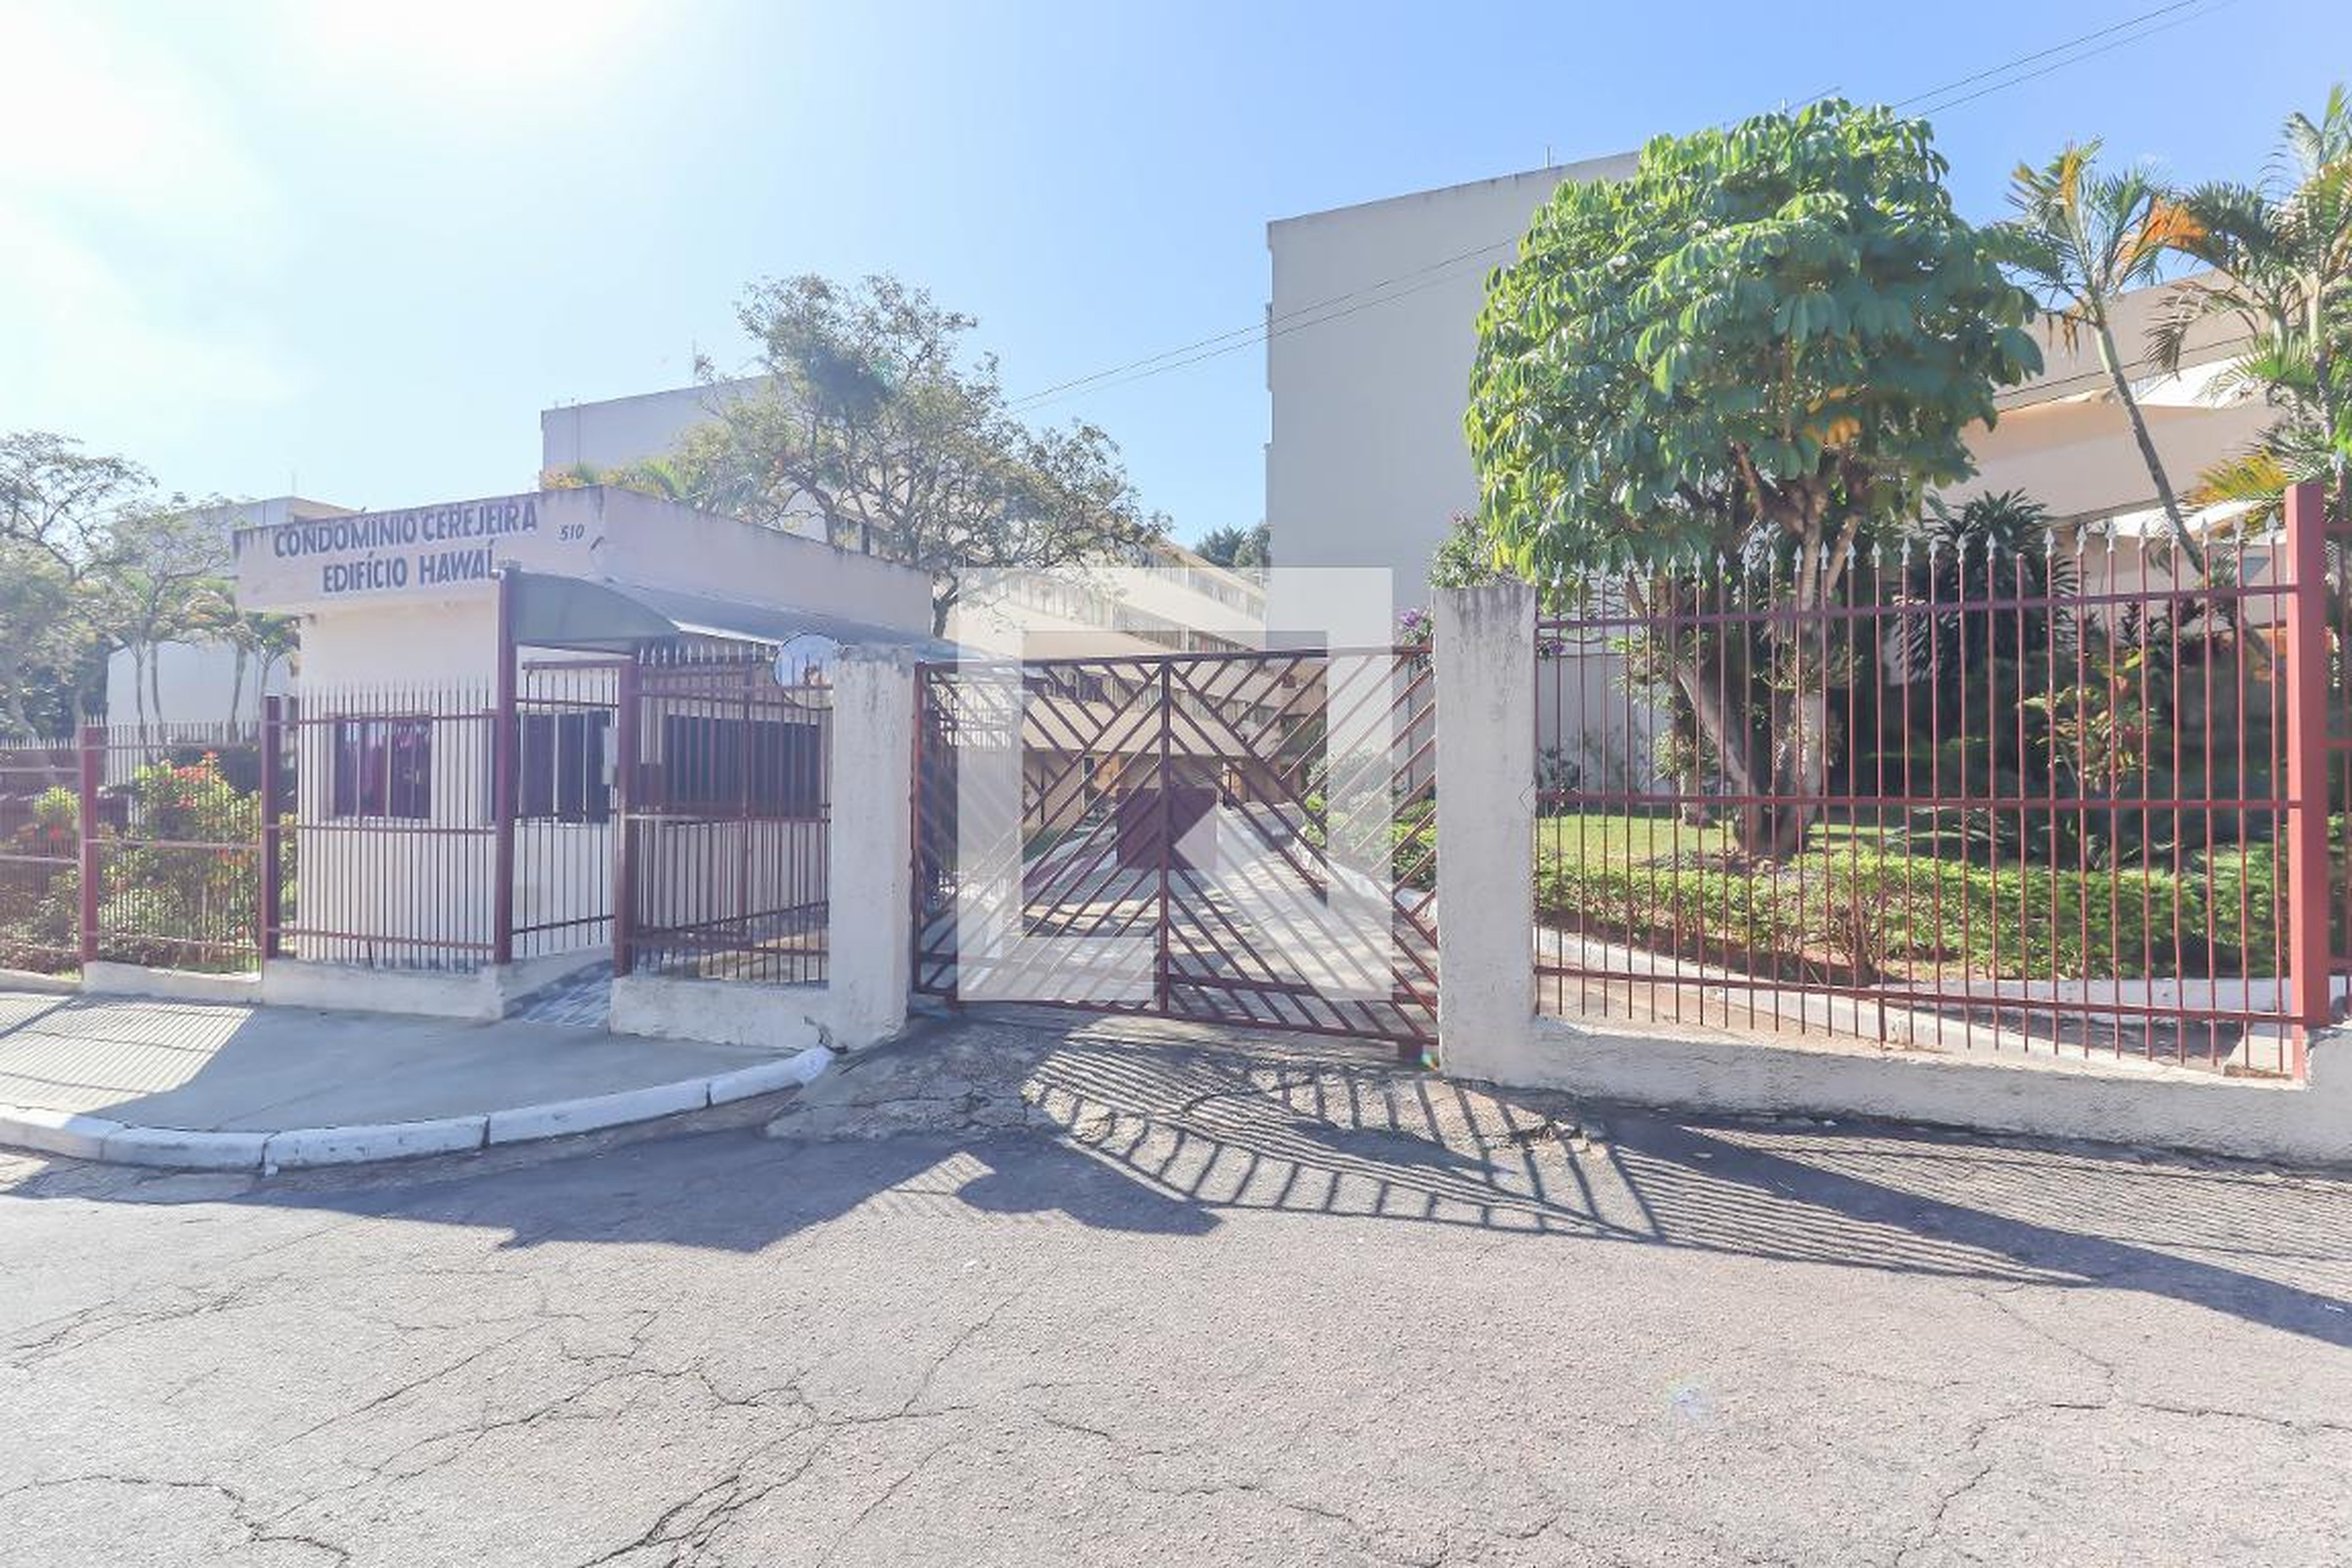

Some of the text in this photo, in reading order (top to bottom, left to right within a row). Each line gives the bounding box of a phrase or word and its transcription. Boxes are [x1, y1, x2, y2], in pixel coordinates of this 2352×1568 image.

[422, 499, 537, 541] CEREJEIRA
[558, 524, 584, 540] 510
[323, 538, 493, 593] EDIFÍCIO HAWAÍ
